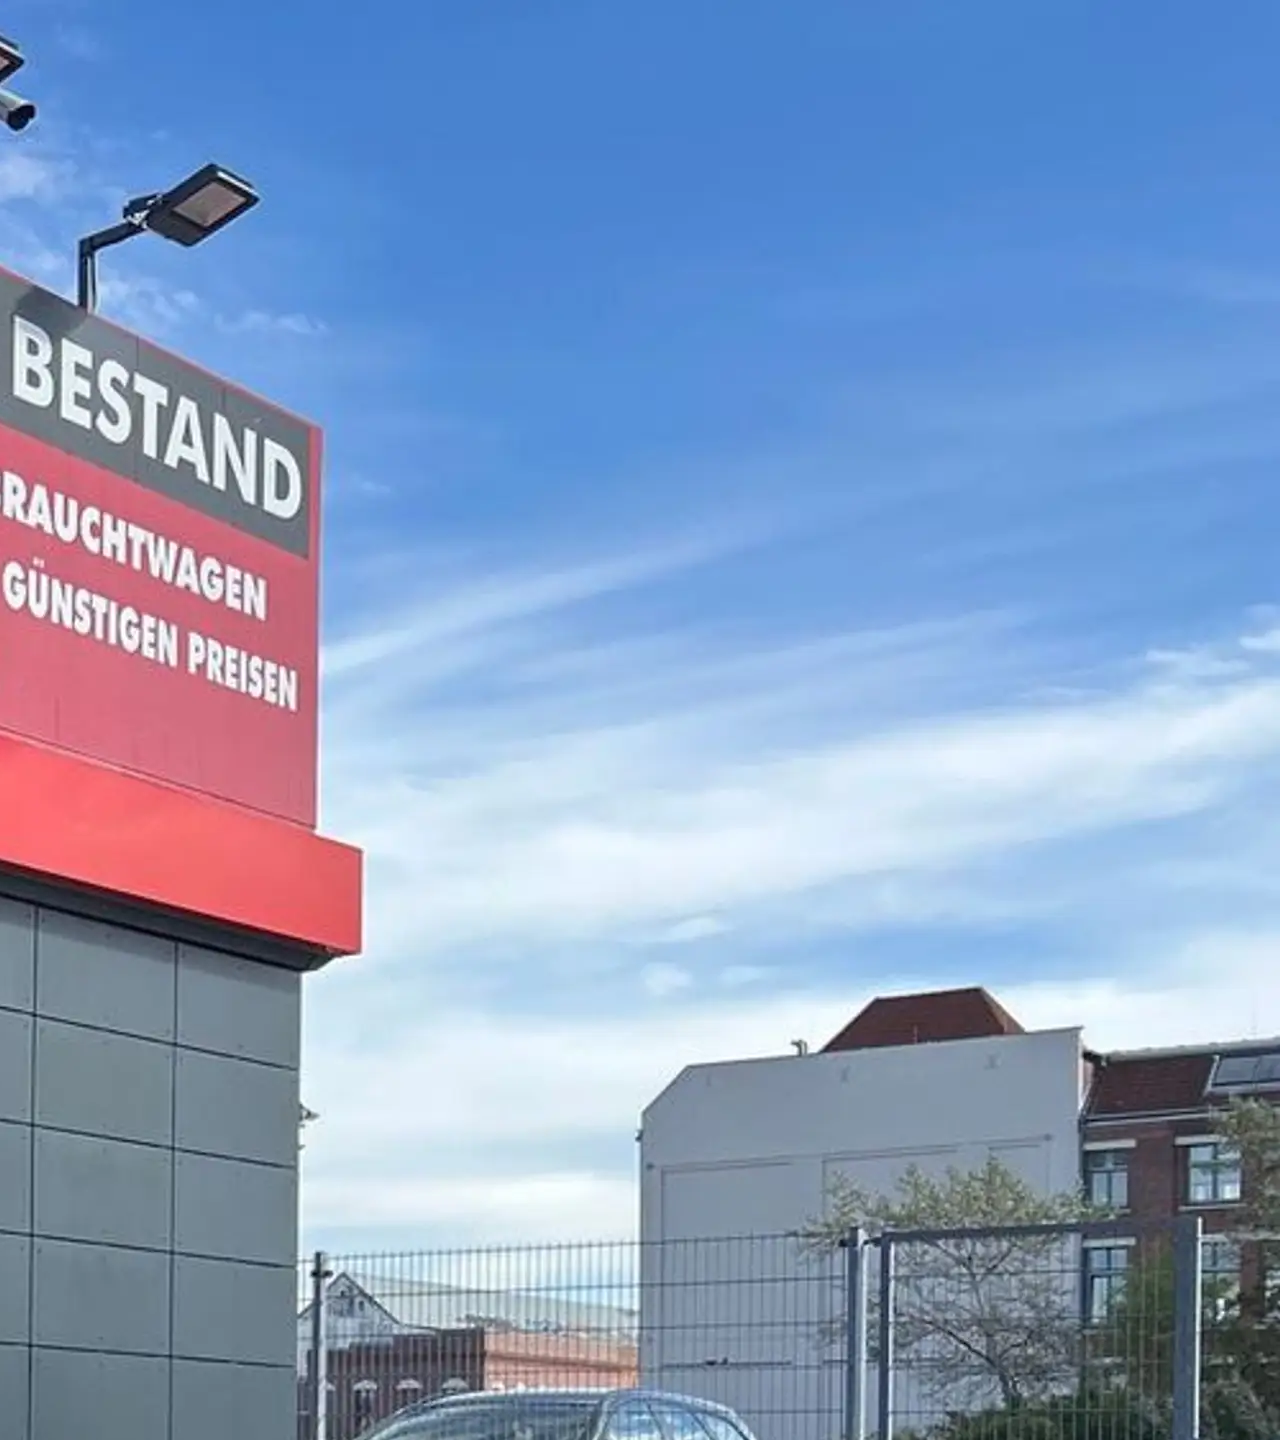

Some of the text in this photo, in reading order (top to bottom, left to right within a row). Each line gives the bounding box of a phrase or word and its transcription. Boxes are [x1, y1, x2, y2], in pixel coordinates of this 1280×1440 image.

[12, 315, 305, 520] BESTAND
[1, 557, 178, 668] GÜNSTIGEN
[187, 632, 298, 712] PREISEN
